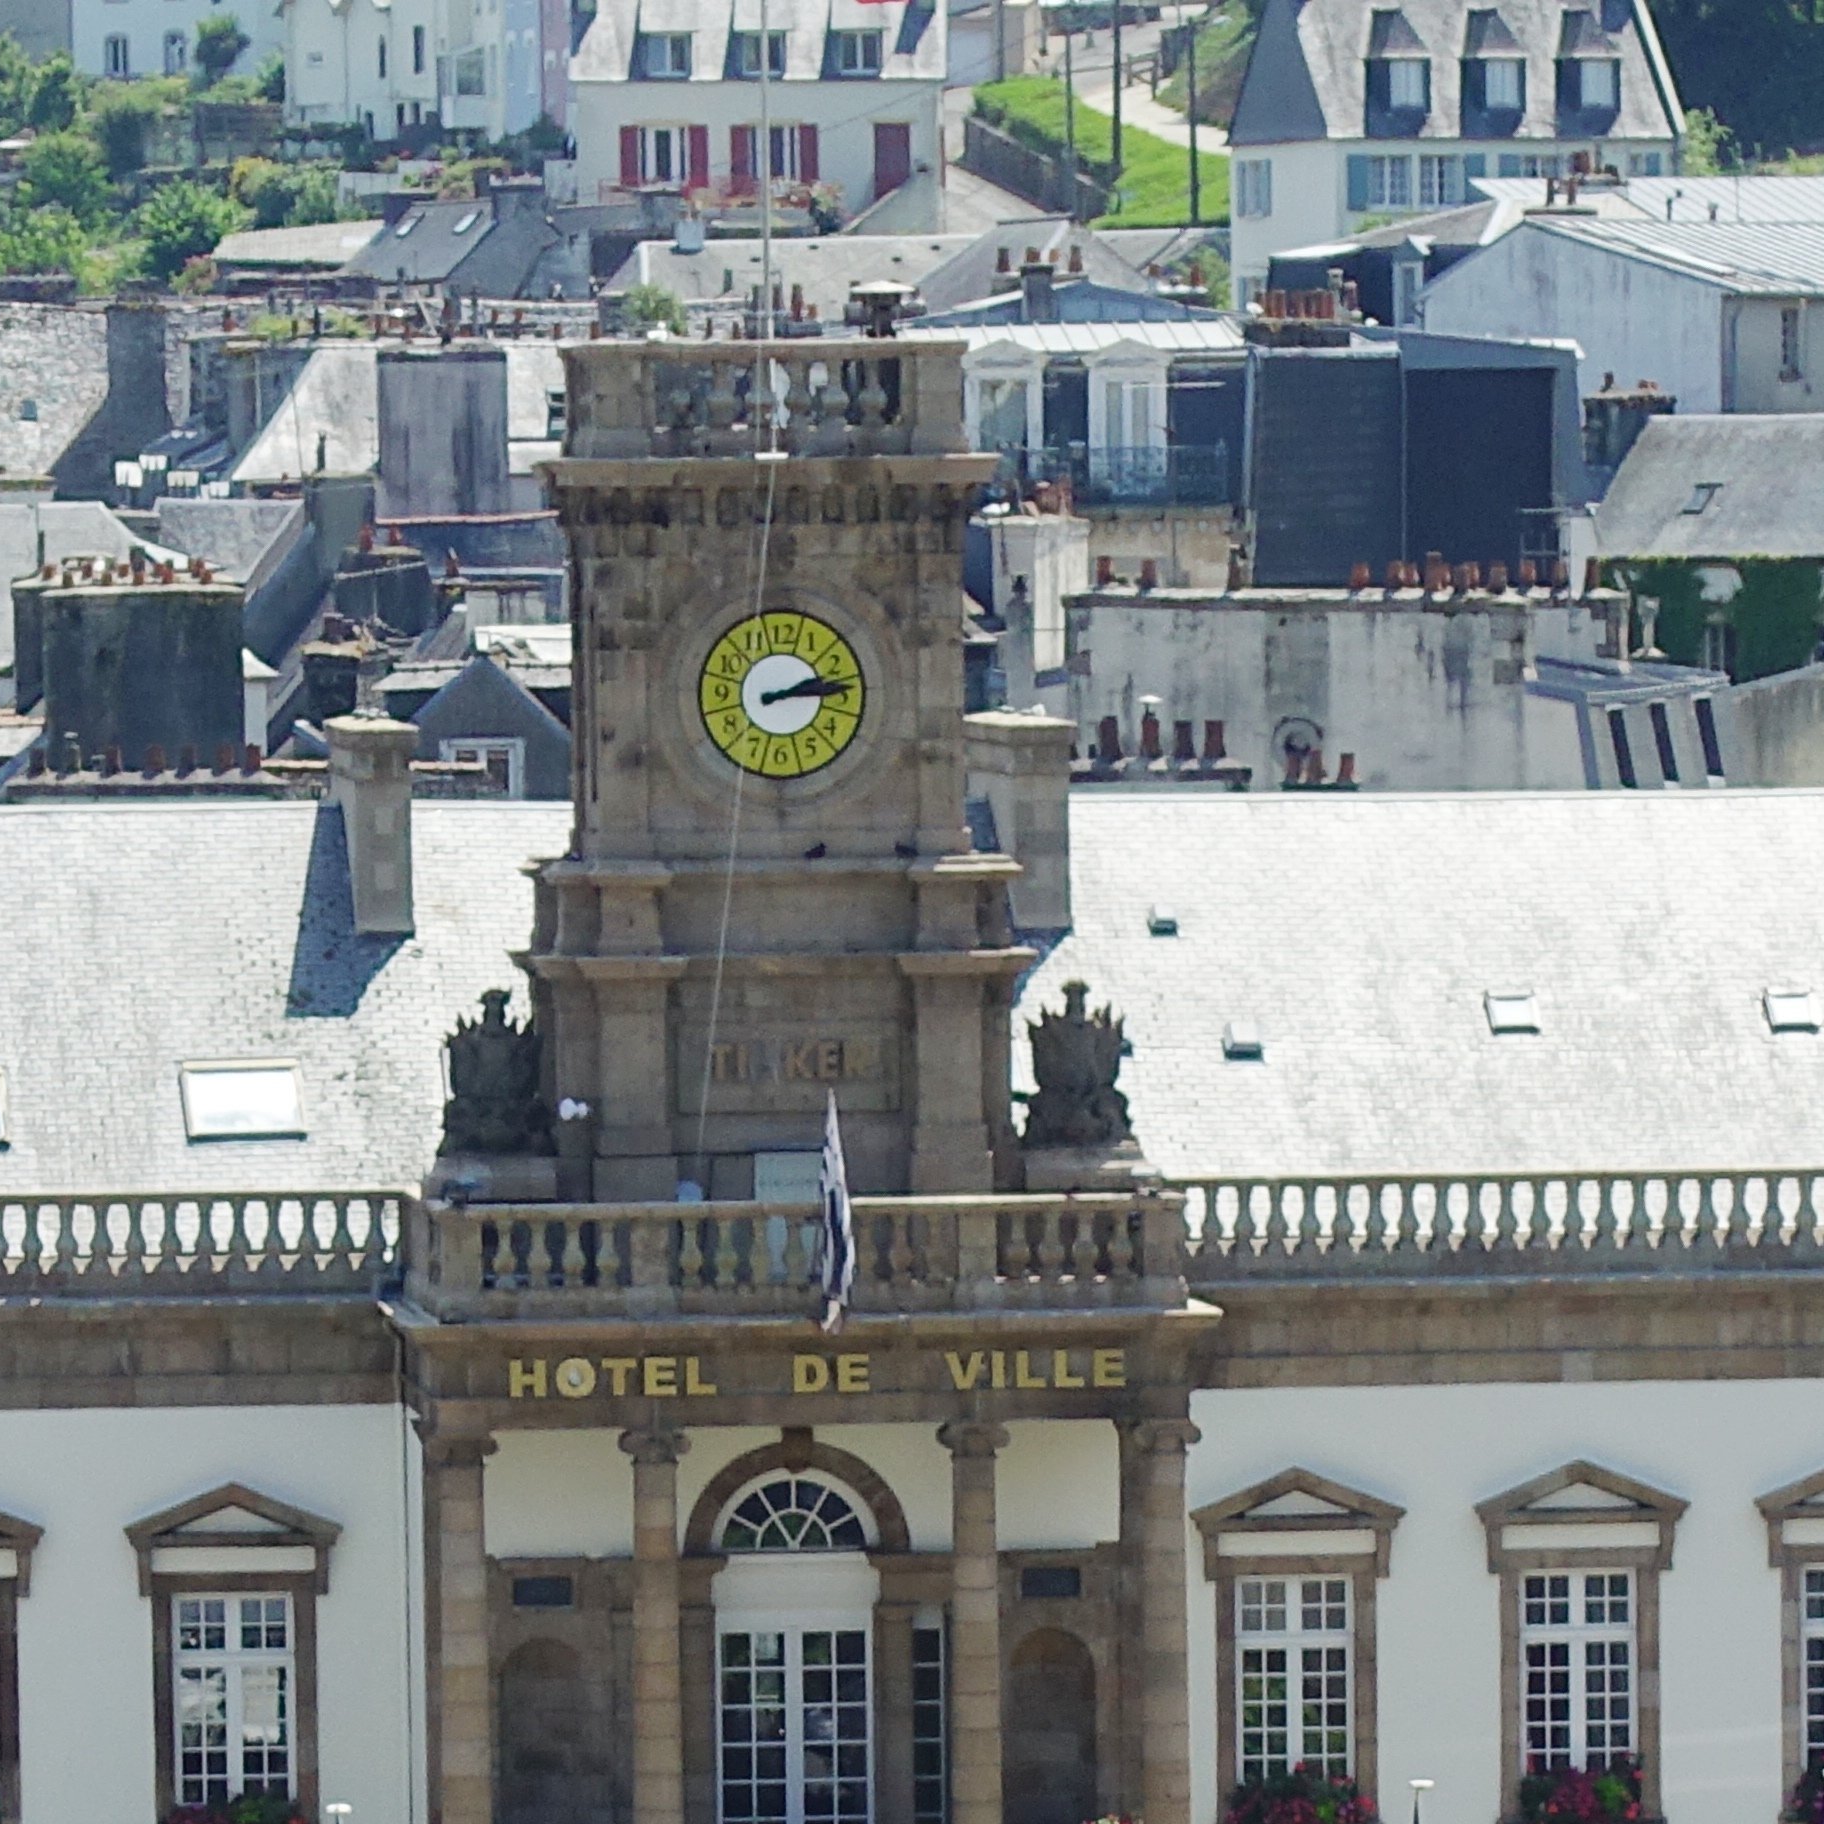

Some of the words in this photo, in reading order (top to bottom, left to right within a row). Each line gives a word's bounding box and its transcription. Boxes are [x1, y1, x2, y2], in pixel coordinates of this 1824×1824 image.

[745, 629, 763, 651] 11
[772, 624, 795, 645] 12
[807, 632, 816, 652] 1
[721, 653, 743, 674] 10
[828, 654, 842, 676] 2
[714, 684, 729, 702] 9
[723, 714, 736, 733] 8
[823, 717, 837, 737] 4
[748, 737, 760, 758] 7
[774, 745, 787, 764] 6
[804, 737, 817, 757] 5
[713, 1043, 749, 1080] TI
[508, 1356, 718, 1398] HOTEL
[793, 1353, 871, 1393] DE
[944, 1349, 1126, 1390] VILLE
